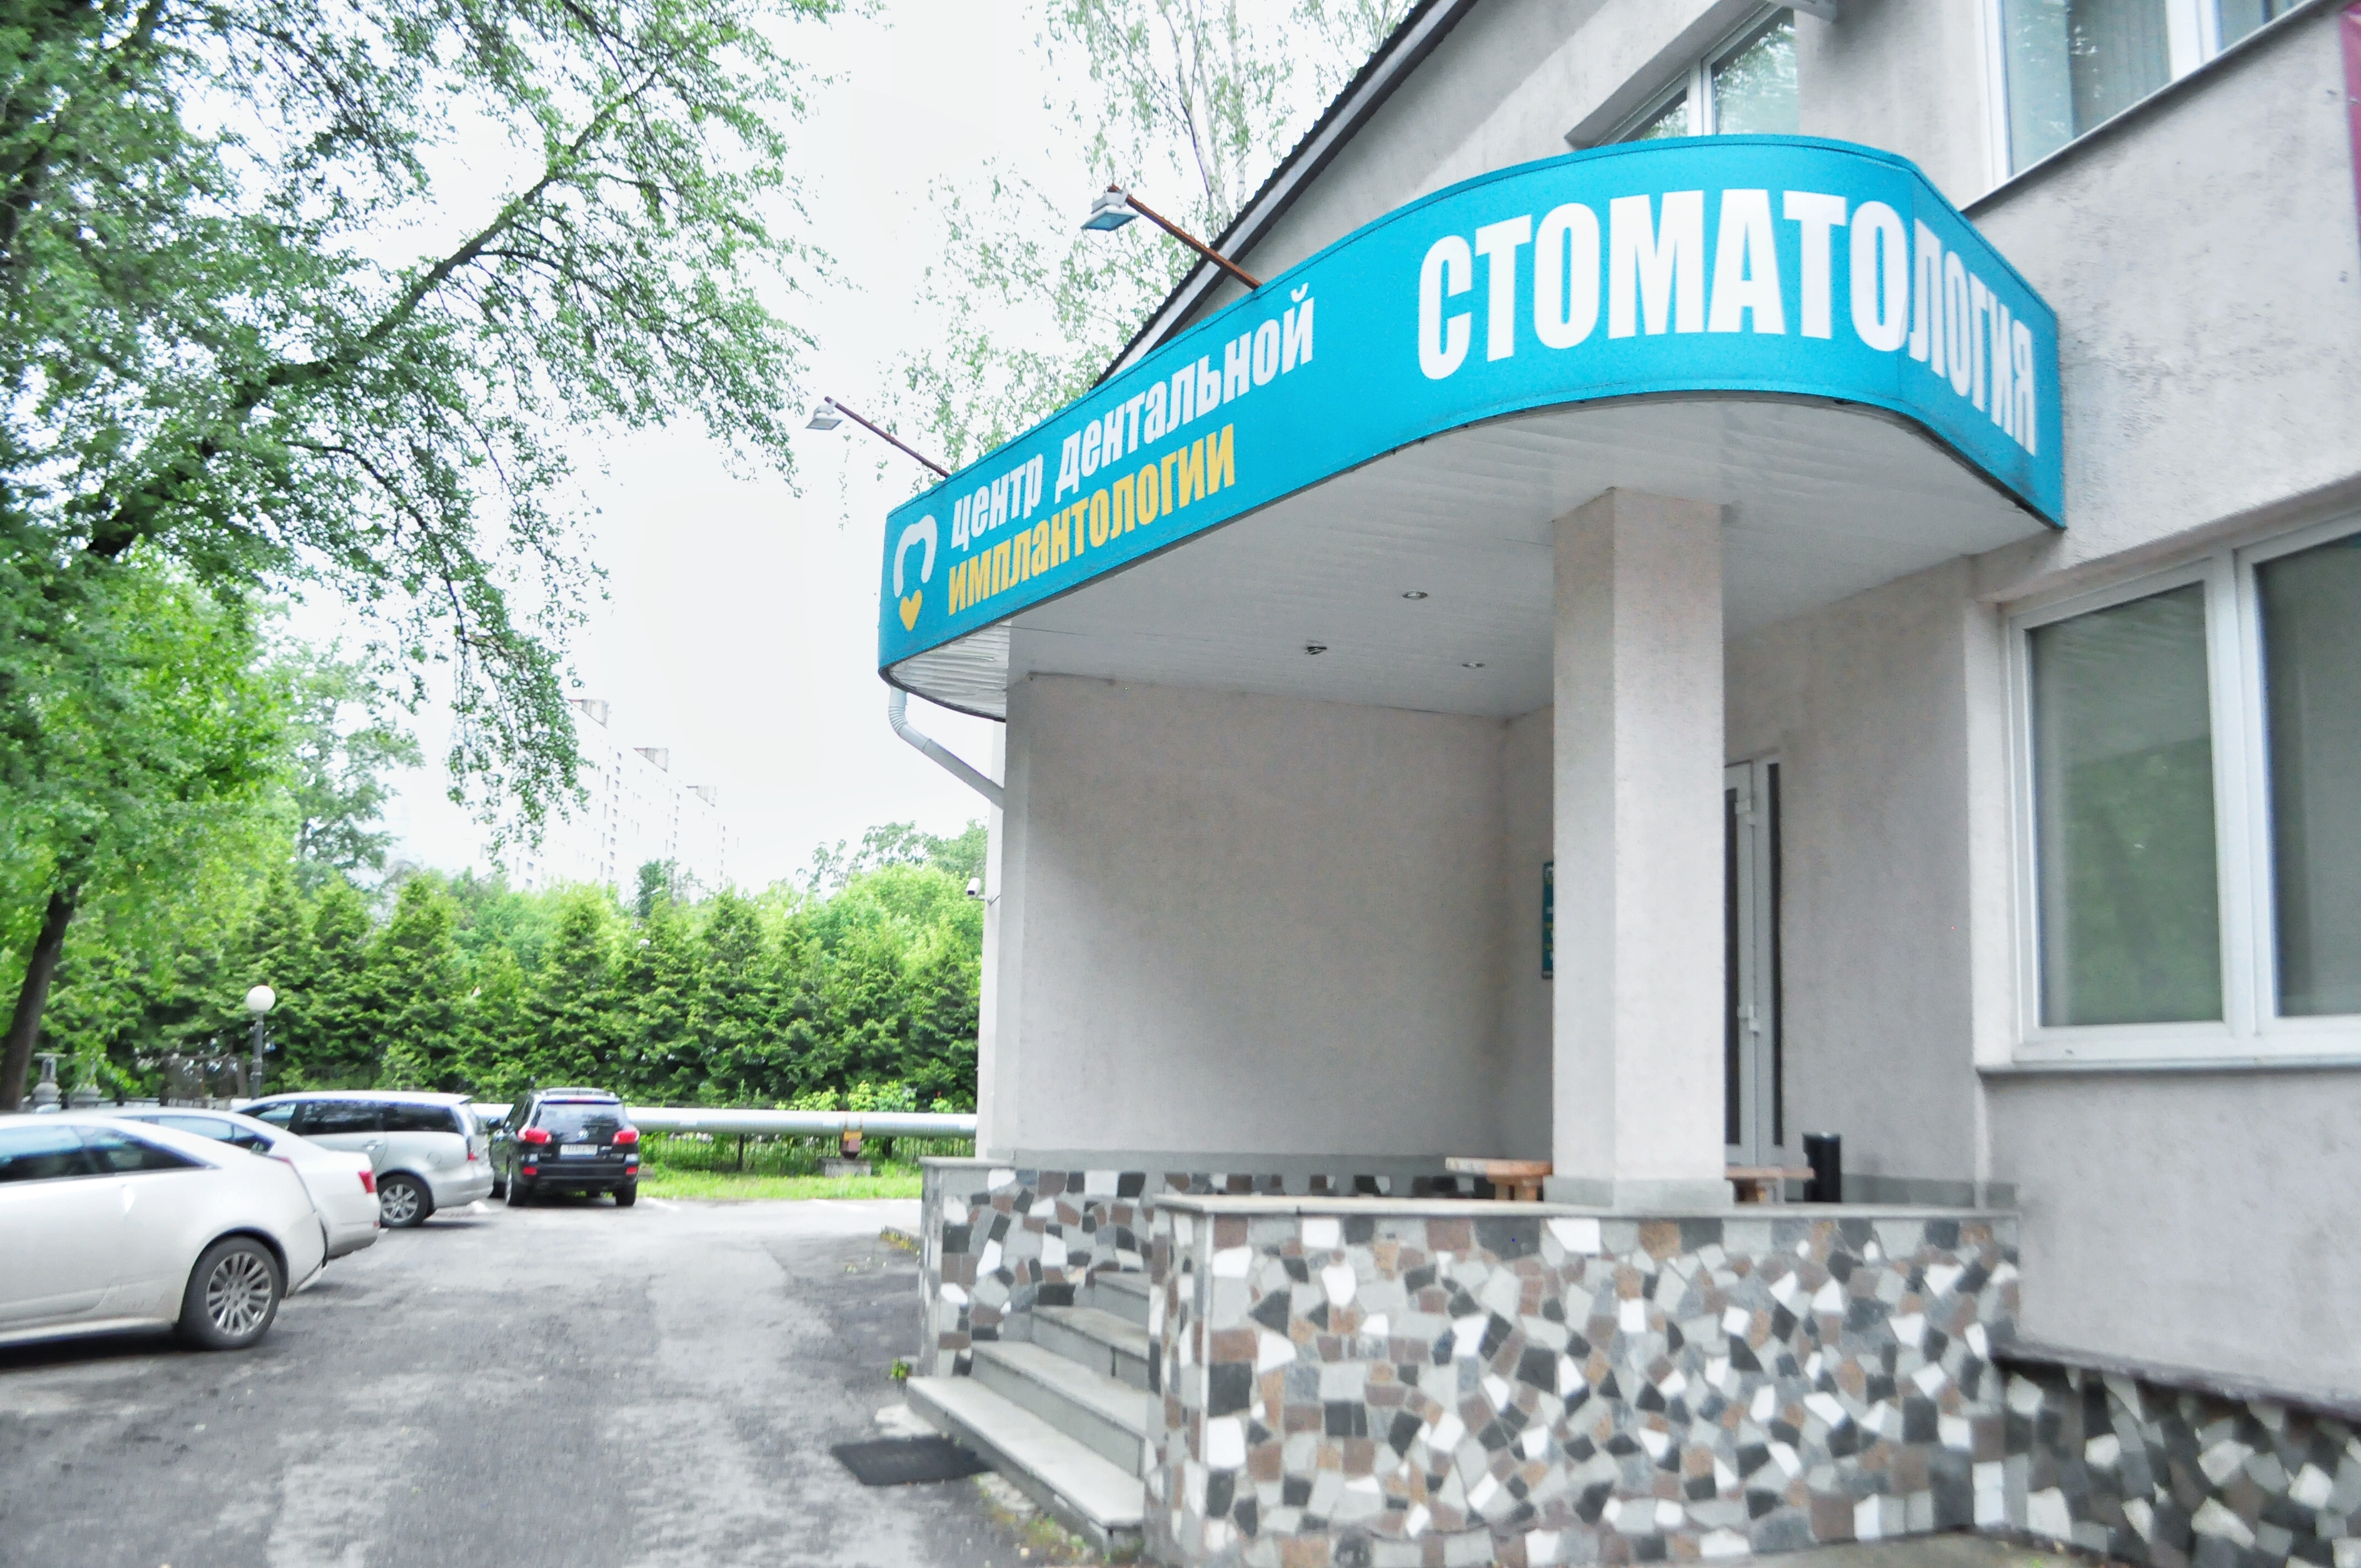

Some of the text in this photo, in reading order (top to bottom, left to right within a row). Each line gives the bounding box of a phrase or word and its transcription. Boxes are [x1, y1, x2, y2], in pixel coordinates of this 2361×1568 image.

[951, 283, 1314, 552] центр дентальной
[1418, 189, 2036, 455] СТОМАТОЛОГИЯ
[948, 423, 1235, 616] имплантологии
